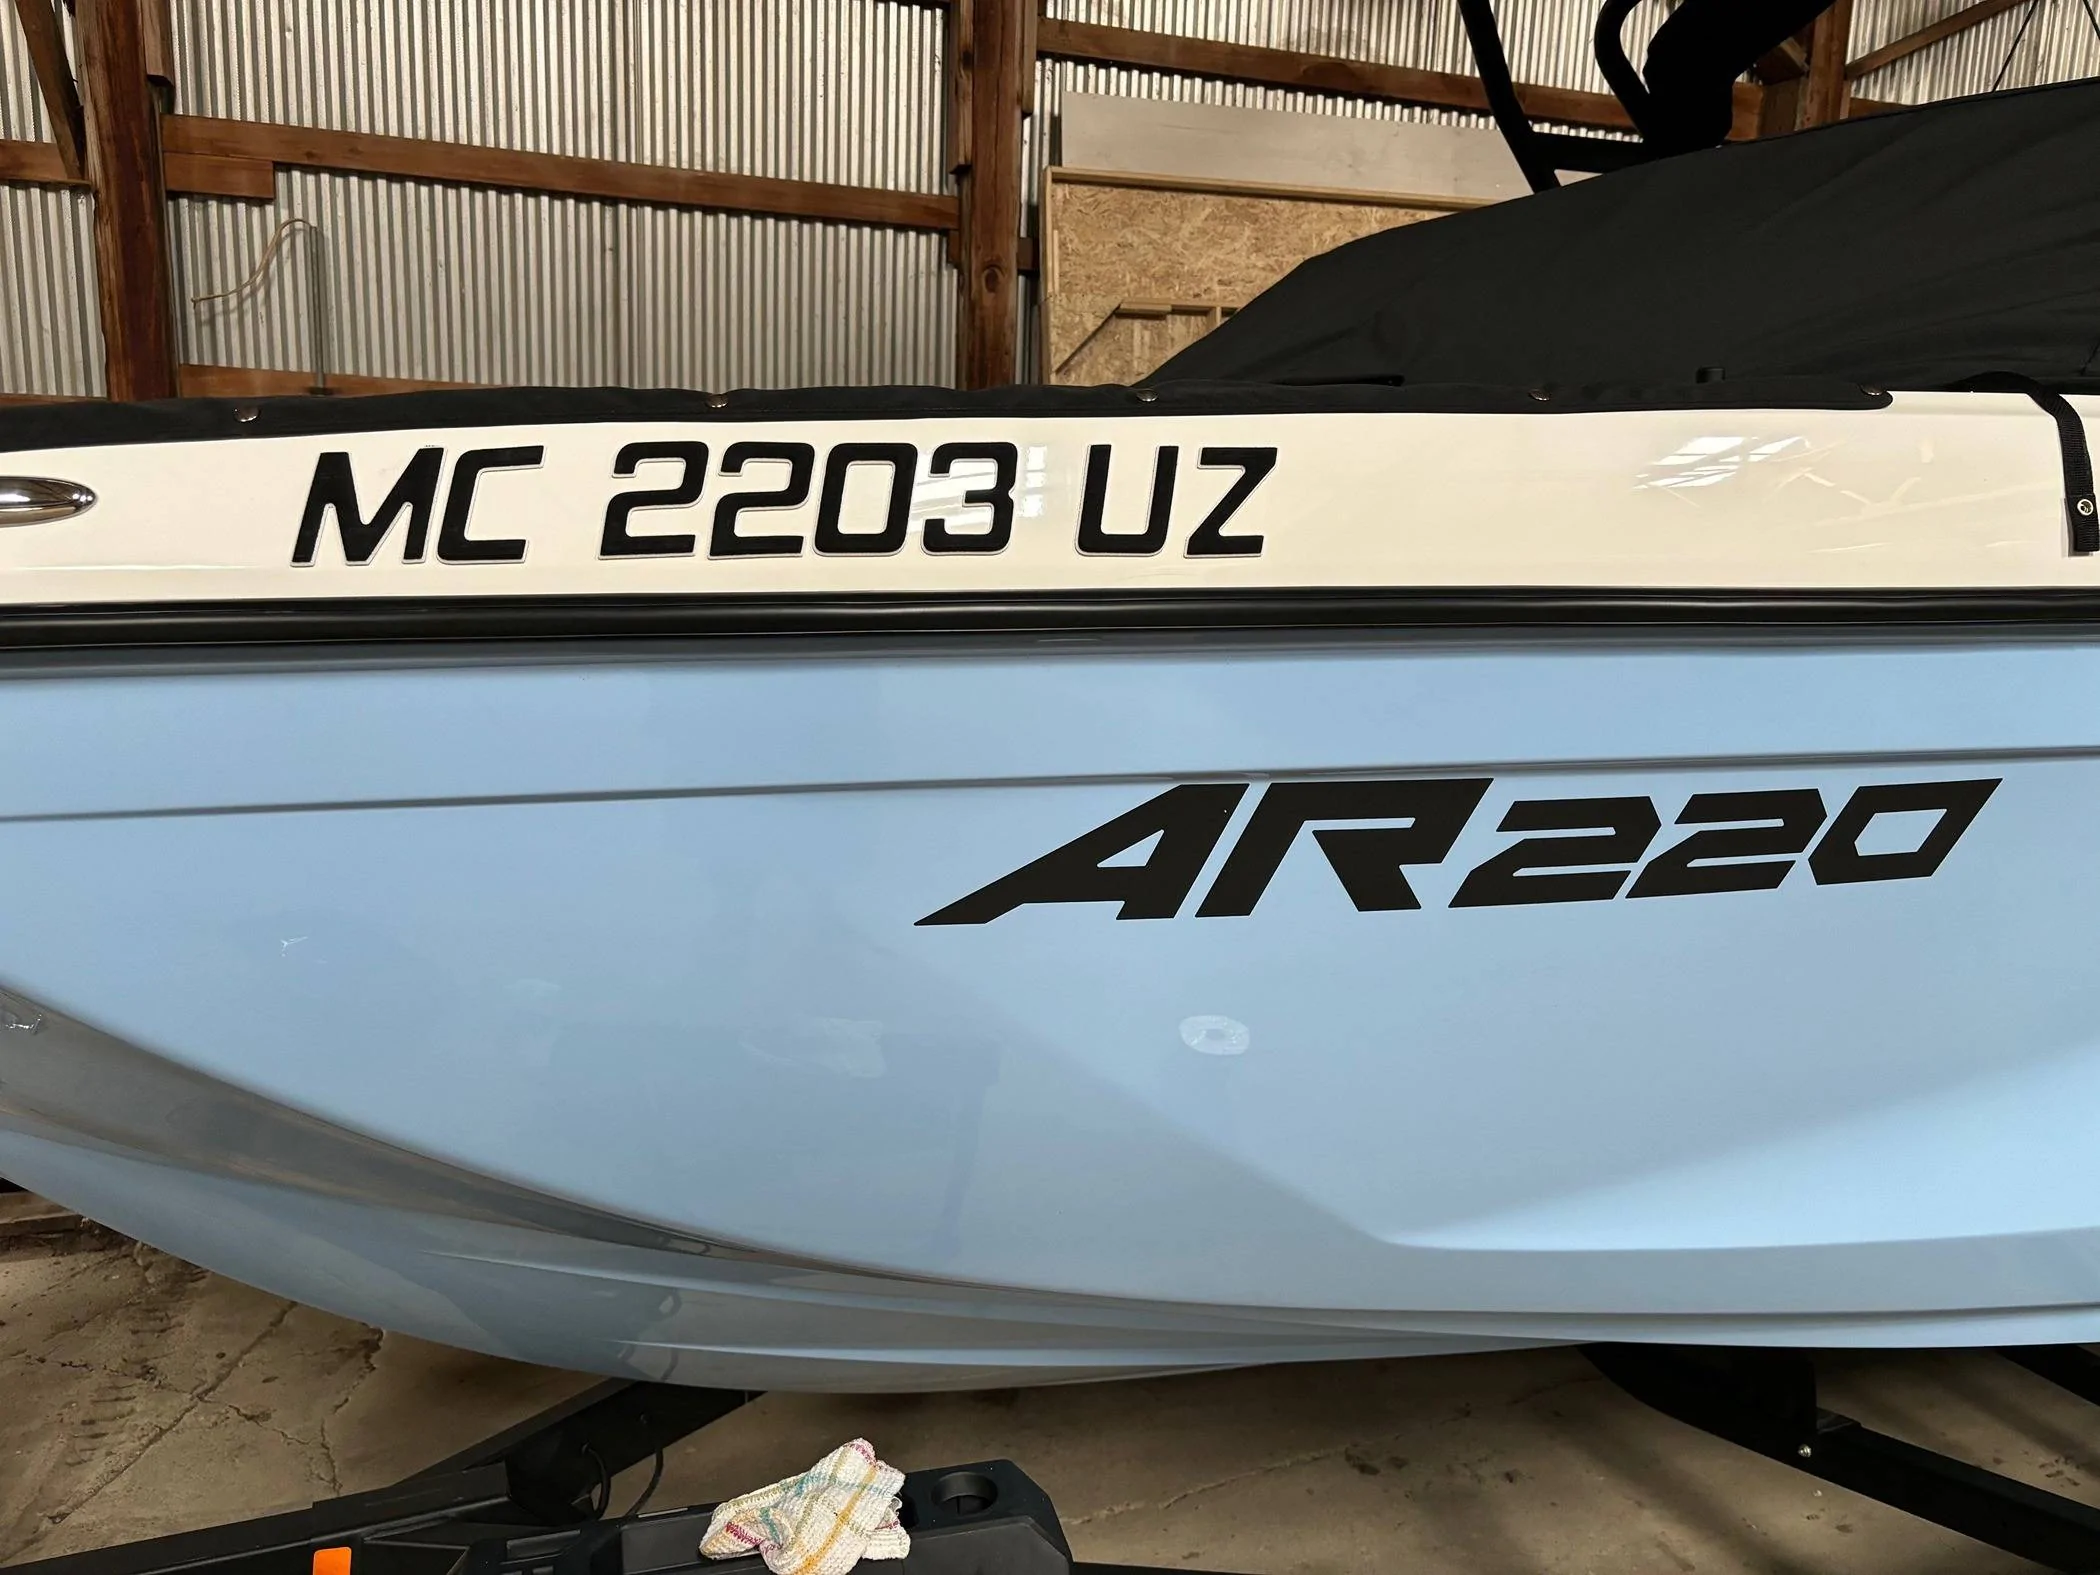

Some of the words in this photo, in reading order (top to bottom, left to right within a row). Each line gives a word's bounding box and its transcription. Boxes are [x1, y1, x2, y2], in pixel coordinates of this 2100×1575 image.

[292, 446, 543, 563] MC
[600, 441, 1017, 557] 2203
[1077, 445, 1279, 556] UZ
